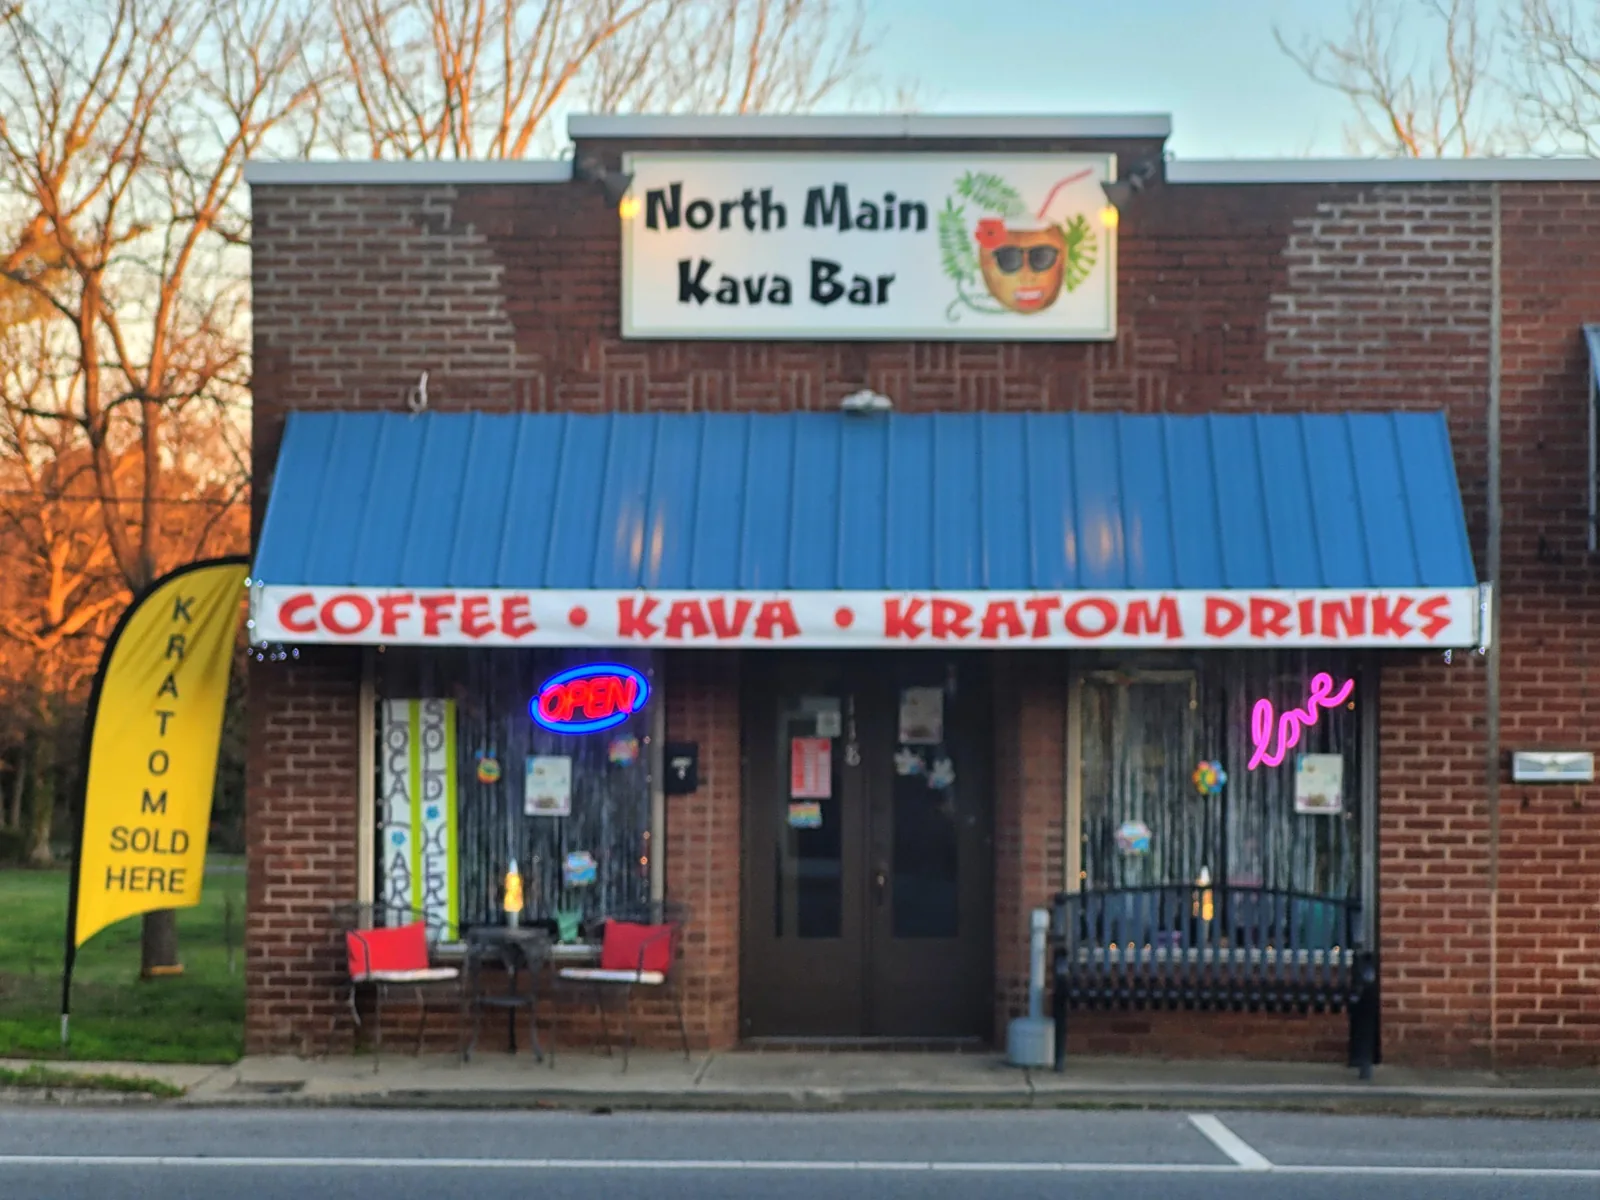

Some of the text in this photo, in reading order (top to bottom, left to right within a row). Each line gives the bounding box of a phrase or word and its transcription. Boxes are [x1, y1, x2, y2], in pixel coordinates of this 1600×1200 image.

[645, 181, 928, 232] North Main
[677, 257, 896, 307] Kava Bar
[278, 592, 1452, 640] COFFEE KAVA KRATOM DRINKS
[141, 595, 195, 816] KRATOM
[538, 675, 637, 723] OPEN
[1248, 672, 1355, 771] love
[385, 698, 411, 827] LOCAL
[420, 698, 447, 929] SOLD HERE
[110, 826, 189, 855] SOLD
[105, 866, 187, 894] HERE
